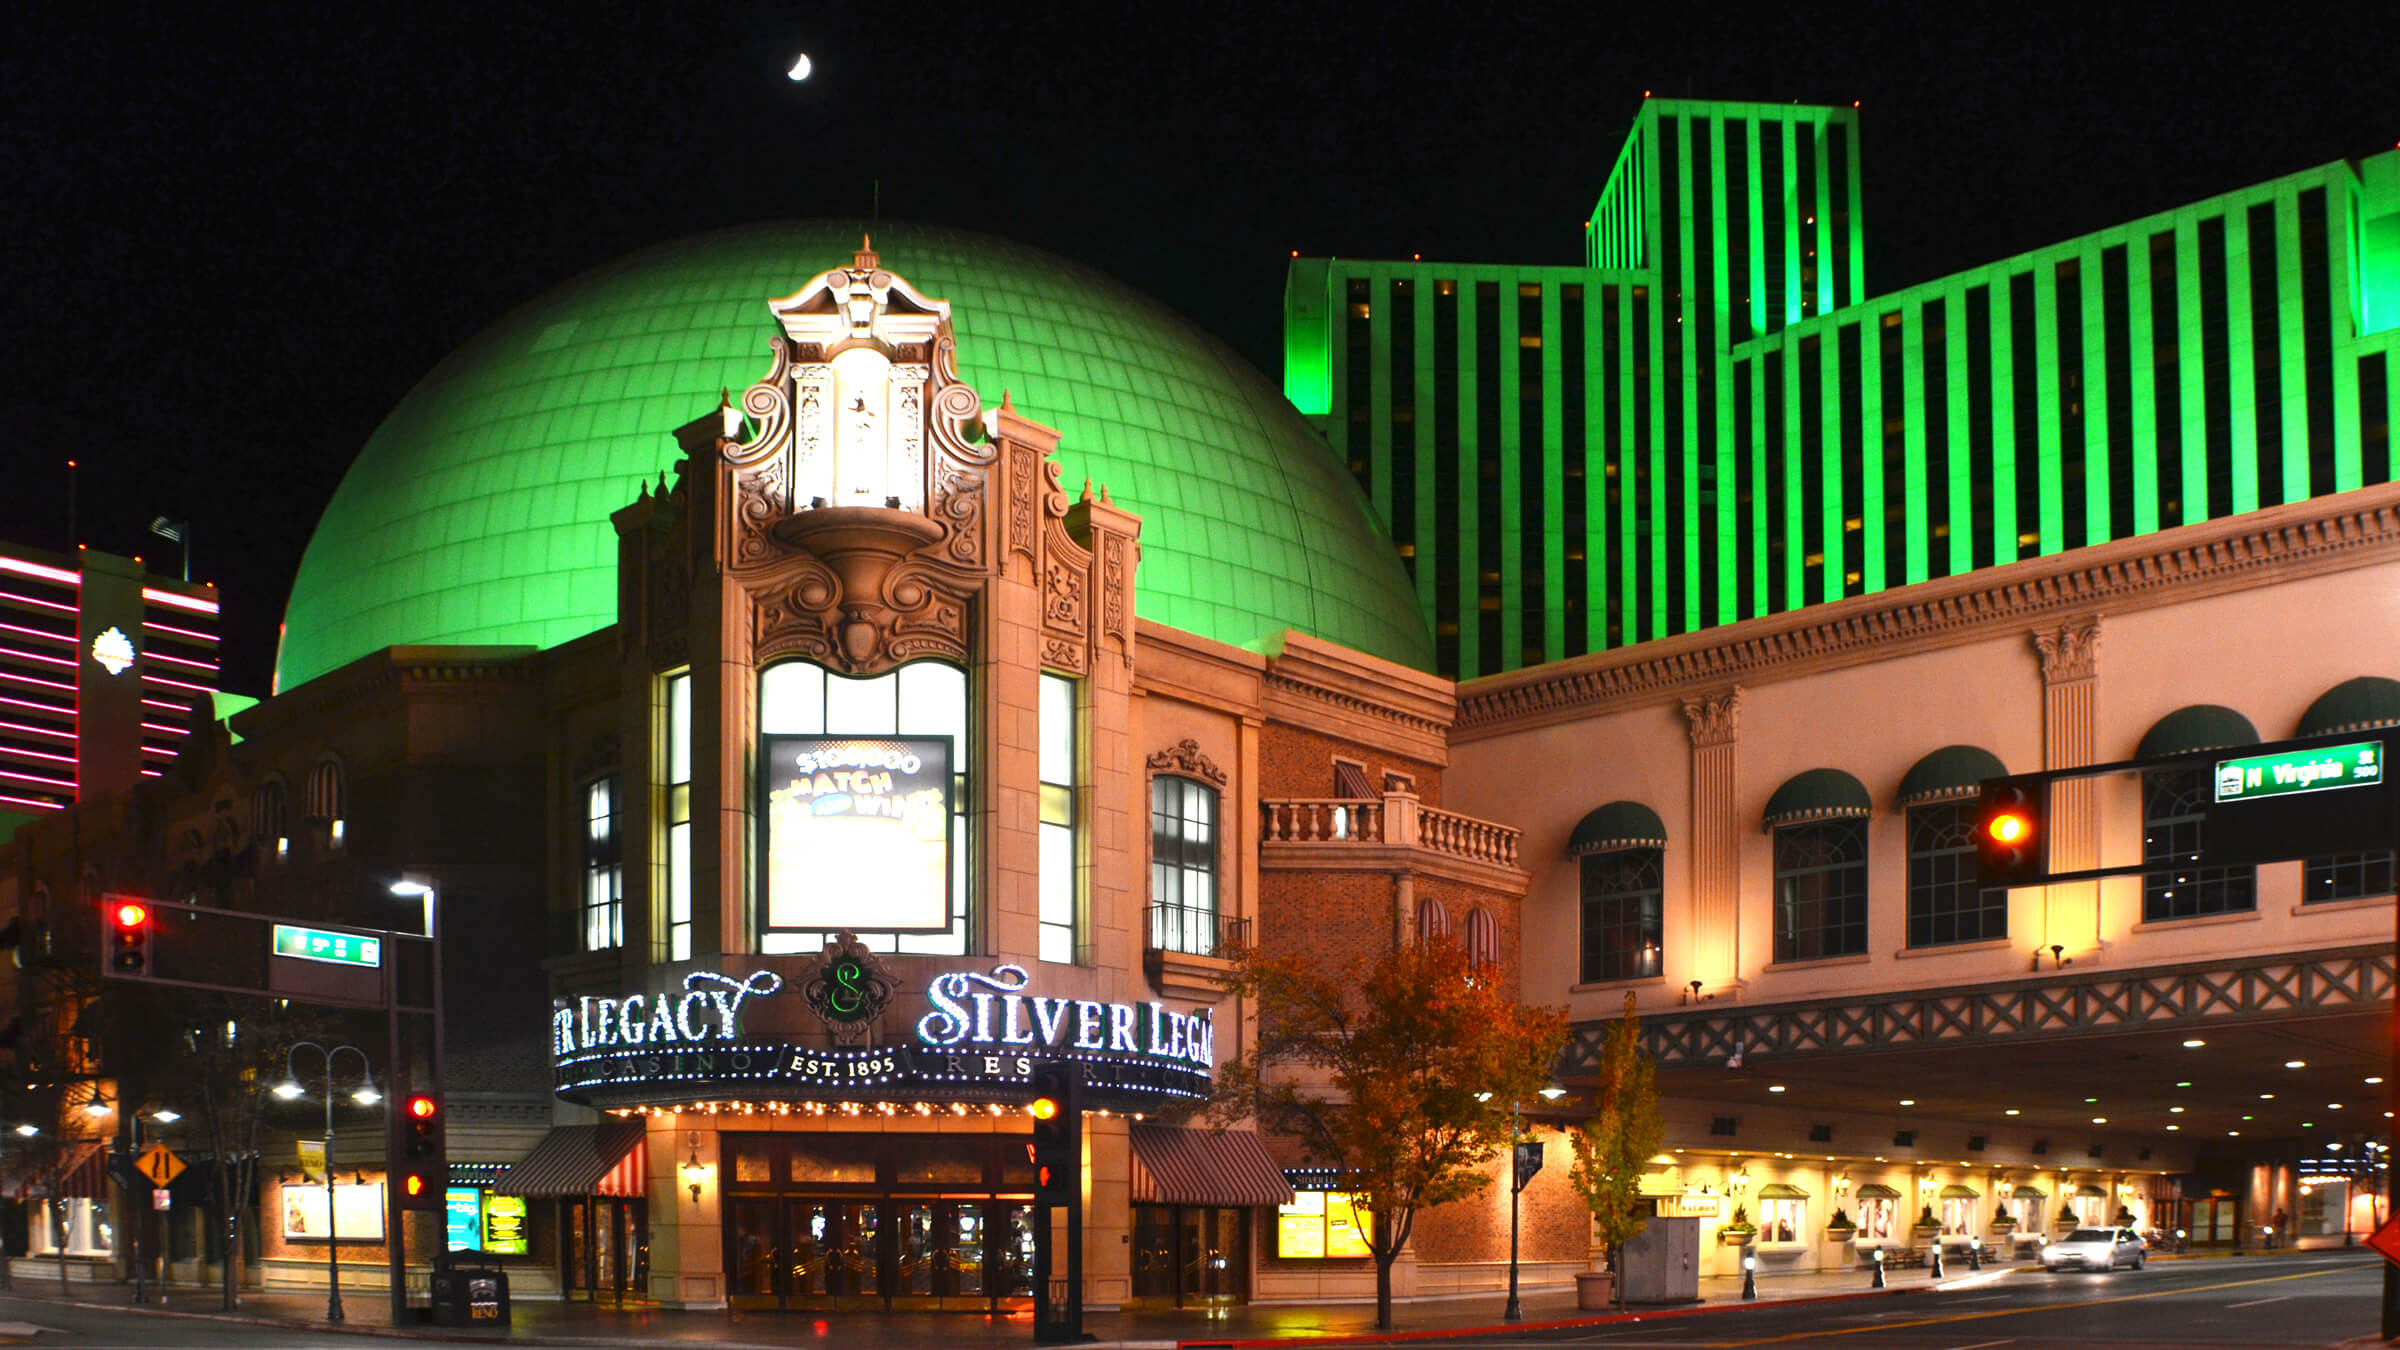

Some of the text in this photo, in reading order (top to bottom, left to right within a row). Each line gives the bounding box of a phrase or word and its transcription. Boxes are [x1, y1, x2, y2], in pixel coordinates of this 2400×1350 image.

[790, 769, 894, 797] MATCH
[2246, 750, 2375, 789] N Virginia St
[855, 794, 915, 820] WIN
[579, 969, 784, 1049] LEGACY
[917, 964, 1138, 1053] SILVER
[601, 1053, 752, 1076] CASINO
[790, 1055, 895, 1078] EST. 1895
[946, 1055, 1125, 1081] RESRT
